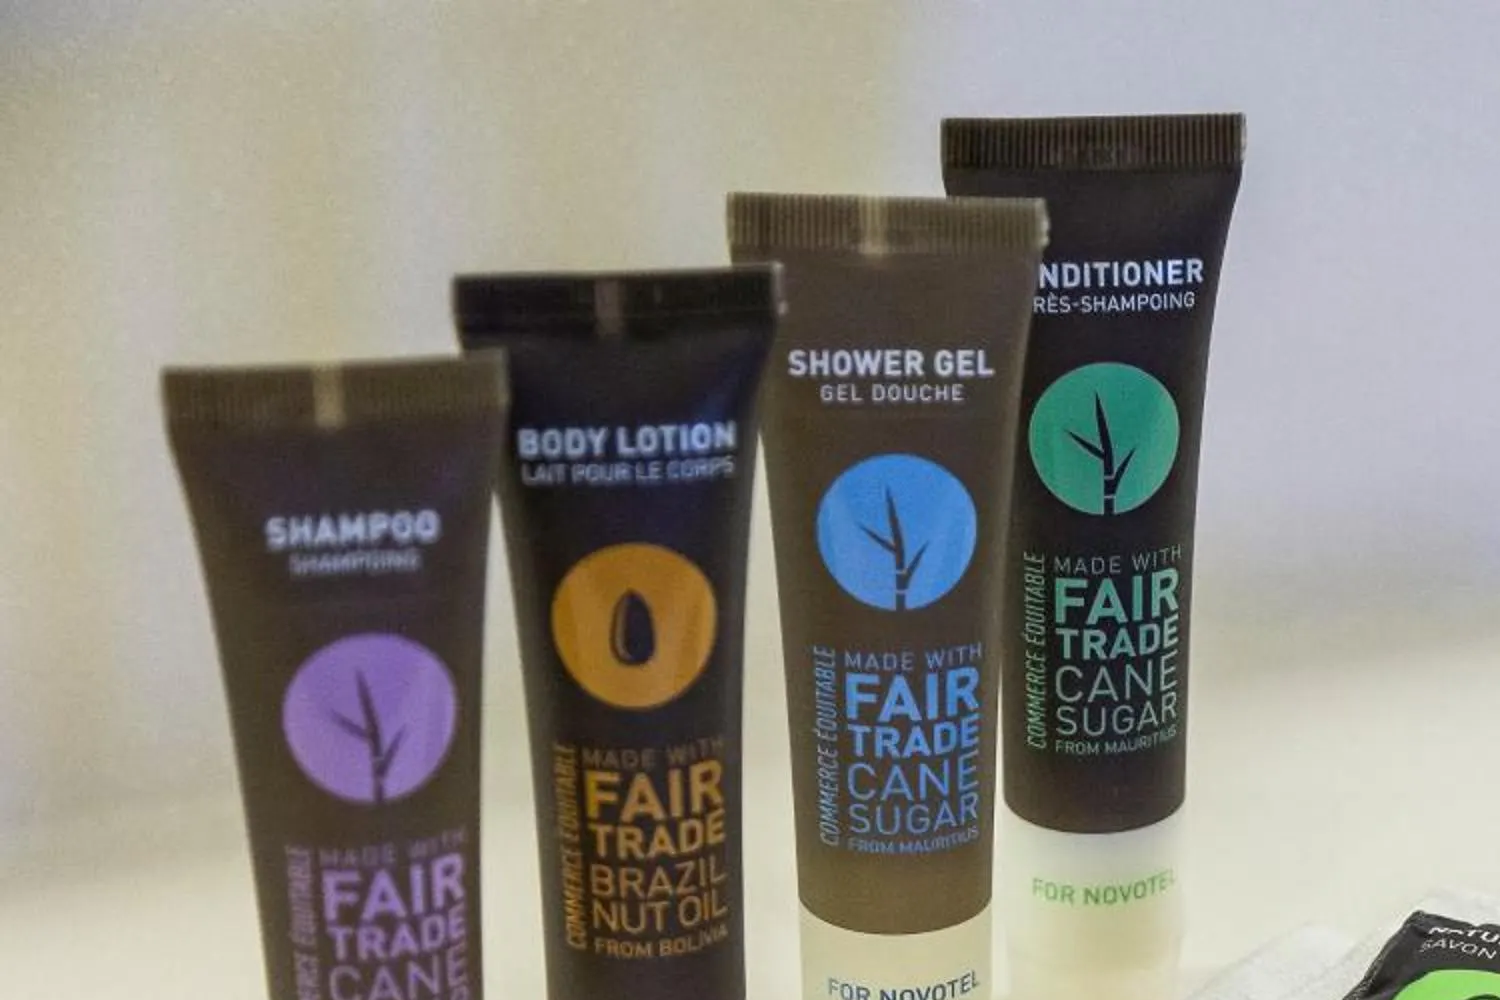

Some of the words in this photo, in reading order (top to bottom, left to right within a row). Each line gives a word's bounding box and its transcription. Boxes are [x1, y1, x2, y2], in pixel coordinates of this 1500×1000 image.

[1039, 258, 1204, 288] NDITIONER
[1033, 291, 1195, 313] RÈS-SHAMPOING
[787, 349, 925, 377] SHOWER
[933, 349, 996, 377] GEL
[820, 383, 863, 402] GEL
[872, 383, 965, 402] DOUCHE
[516, 425, 609, 459] BODY
[616, 420, 737, 456] LOTION
[520, 462, 566, 485] LAIT
[571, 461, 628, 484] POUR
[636, 459, 662, 480] LE
[667, 454, 735, 479] CORPS
[265, 509, 441, 550] SHAMPOO
[1053, 556, 1122, 575] MADE
[1131, 543, 1182, 571] WITH
[1054, 567, 1179, 624] FAIR
[844, 651, 915, 671] MADE
[925, 641, 982, 669] WITH
[1055, 614, 1179, 660] TRADE
[844, 666, 980, 722] FAIR
[1055, 649, 1178, 703] CANE
[1025, 650, 1047, 749] COMMERCE
[1055, 691, 1177, 736] SUGAR
[582, 748, 655, 769] MADE
[667, 736, 724, 764] WITH
[847, 713, 980, 759] TRADE
[1055, 739, 1099, 756] FROM
[1104, 723, 1177, 754] MAURITIUS
[584, 759, 724, 822] FAIR
[847, 749, 979, 800] CANE
[817, 748, 839, 846] COMMERCE
[848, 792, 979, 835] SUGAR
[587, 808, 726, 860] TRADE
[848, 837, 897, 853] FROM
[322, 852, 465, 922] FAIR
[590, 855, 728, 899] BRAZIL
[1032, 877, 1075, 904] FOR
[1083, 868, 1176, 905] NOVOTEL
[327, 902, 466, 961] TRADE
[592, 900, 670, 933] NUT
[678, 889, 728, 927] OIL
[594, 937, 651, 958] FROM
[658, 923, 729, 956] BOLIVIA
[1419, 938, 1497, 960] SAVON
